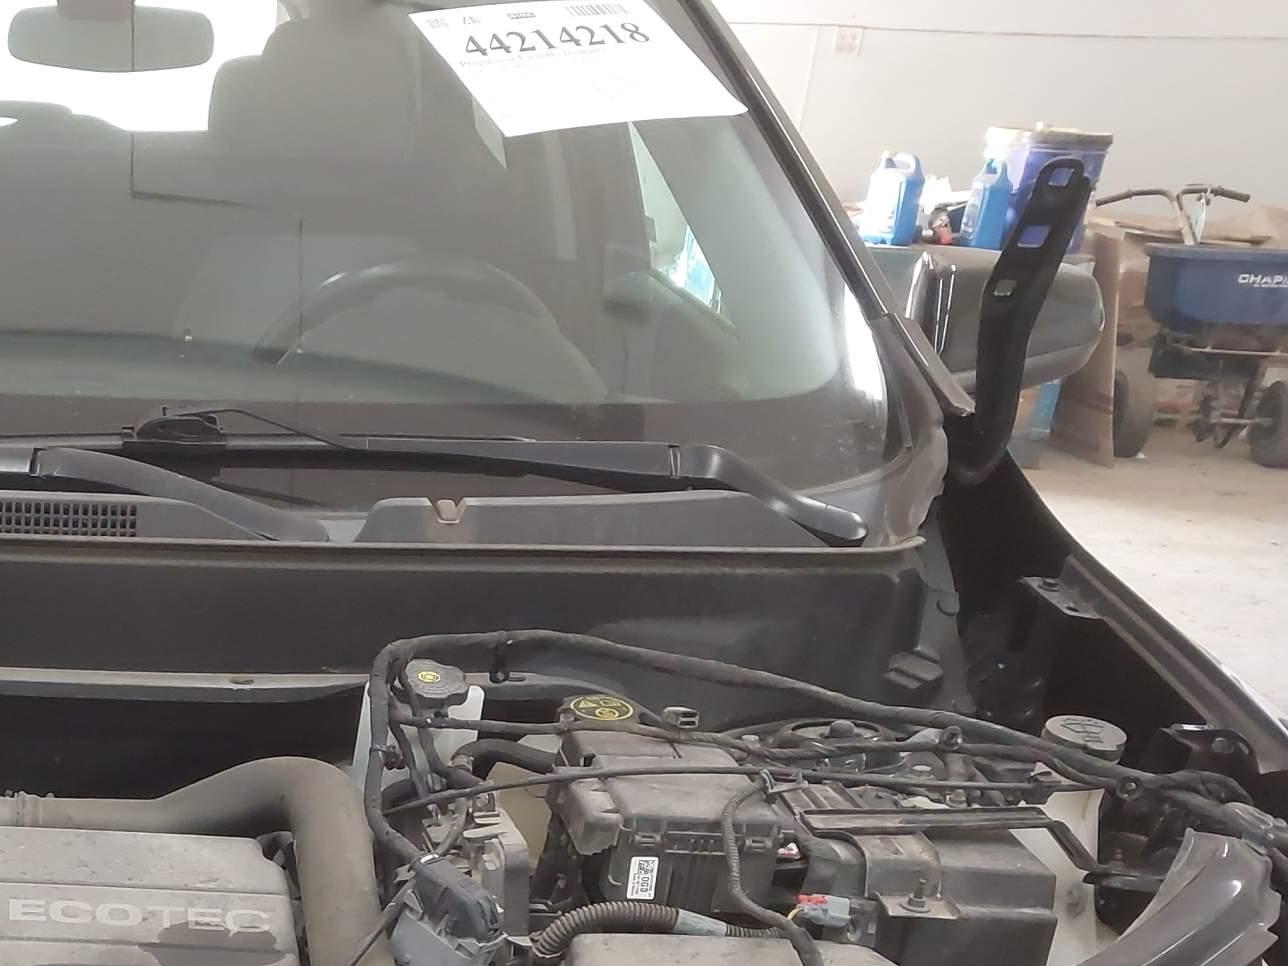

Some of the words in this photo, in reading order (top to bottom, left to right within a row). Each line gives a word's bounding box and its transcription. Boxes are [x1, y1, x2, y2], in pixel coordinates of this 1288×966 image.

[465, 22, 650, 57] 44214218
[1238, 273, 1288, 284] CHAPI
[8, 898, 271, 933] ECOTEC
